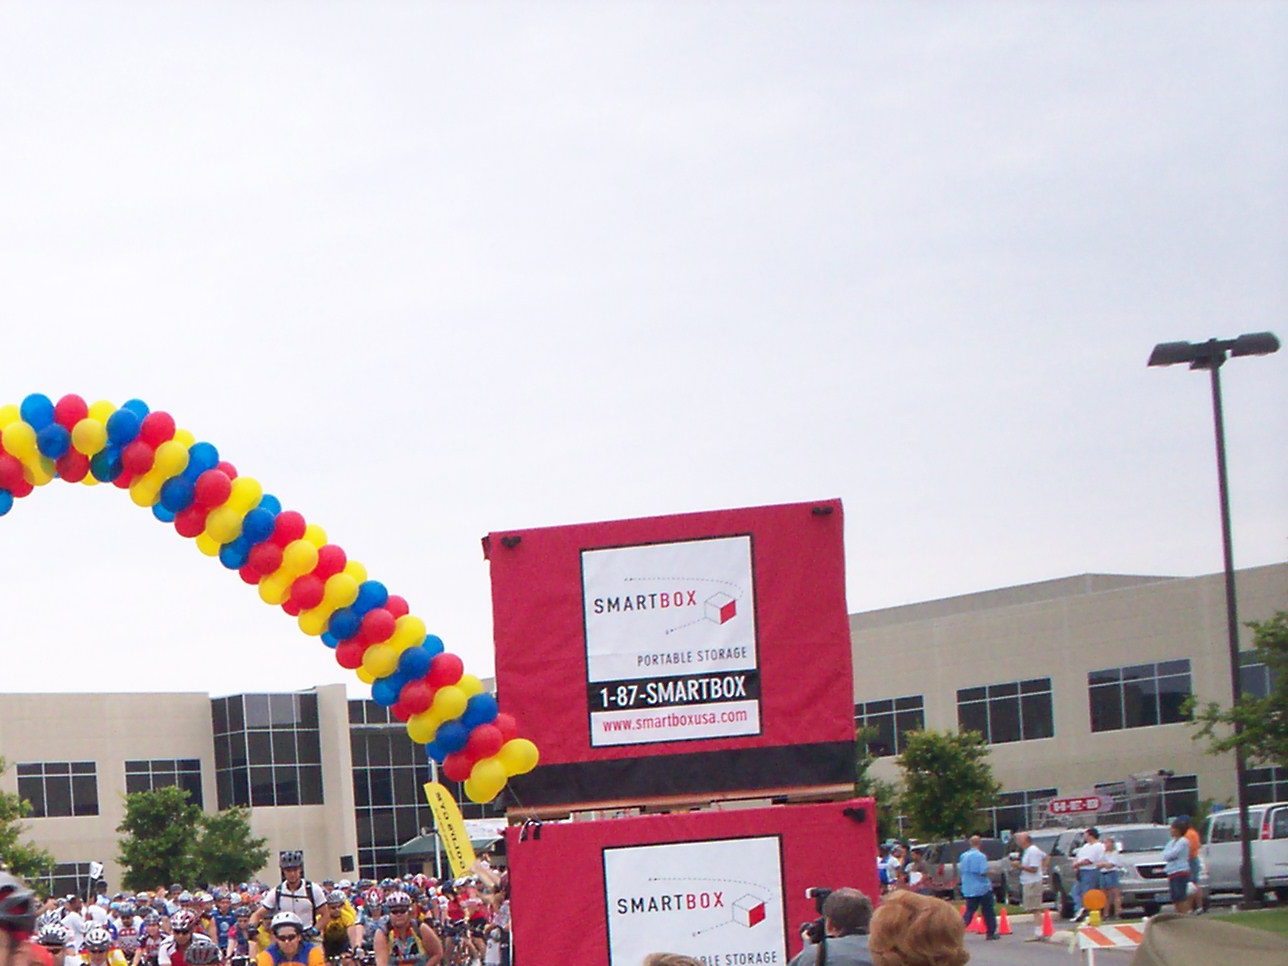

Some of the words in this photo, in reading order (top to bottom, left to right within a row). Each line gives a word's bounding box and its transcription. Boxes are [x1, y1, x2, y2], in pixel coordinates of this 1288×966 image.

[593, 590, 697, 614] SMARTBOX
[637, 650, 692, 667] PORTABLE
[697, 646, 747, 662] STORAGE
[599, 676, 746, 708] 1-87-SMARTBOX
[603, 709, 747, 731] www.smartboxusa.com
[617, 891, 724, 914] SMARTBOX
[725, 951, 777, 966] STORAGE
